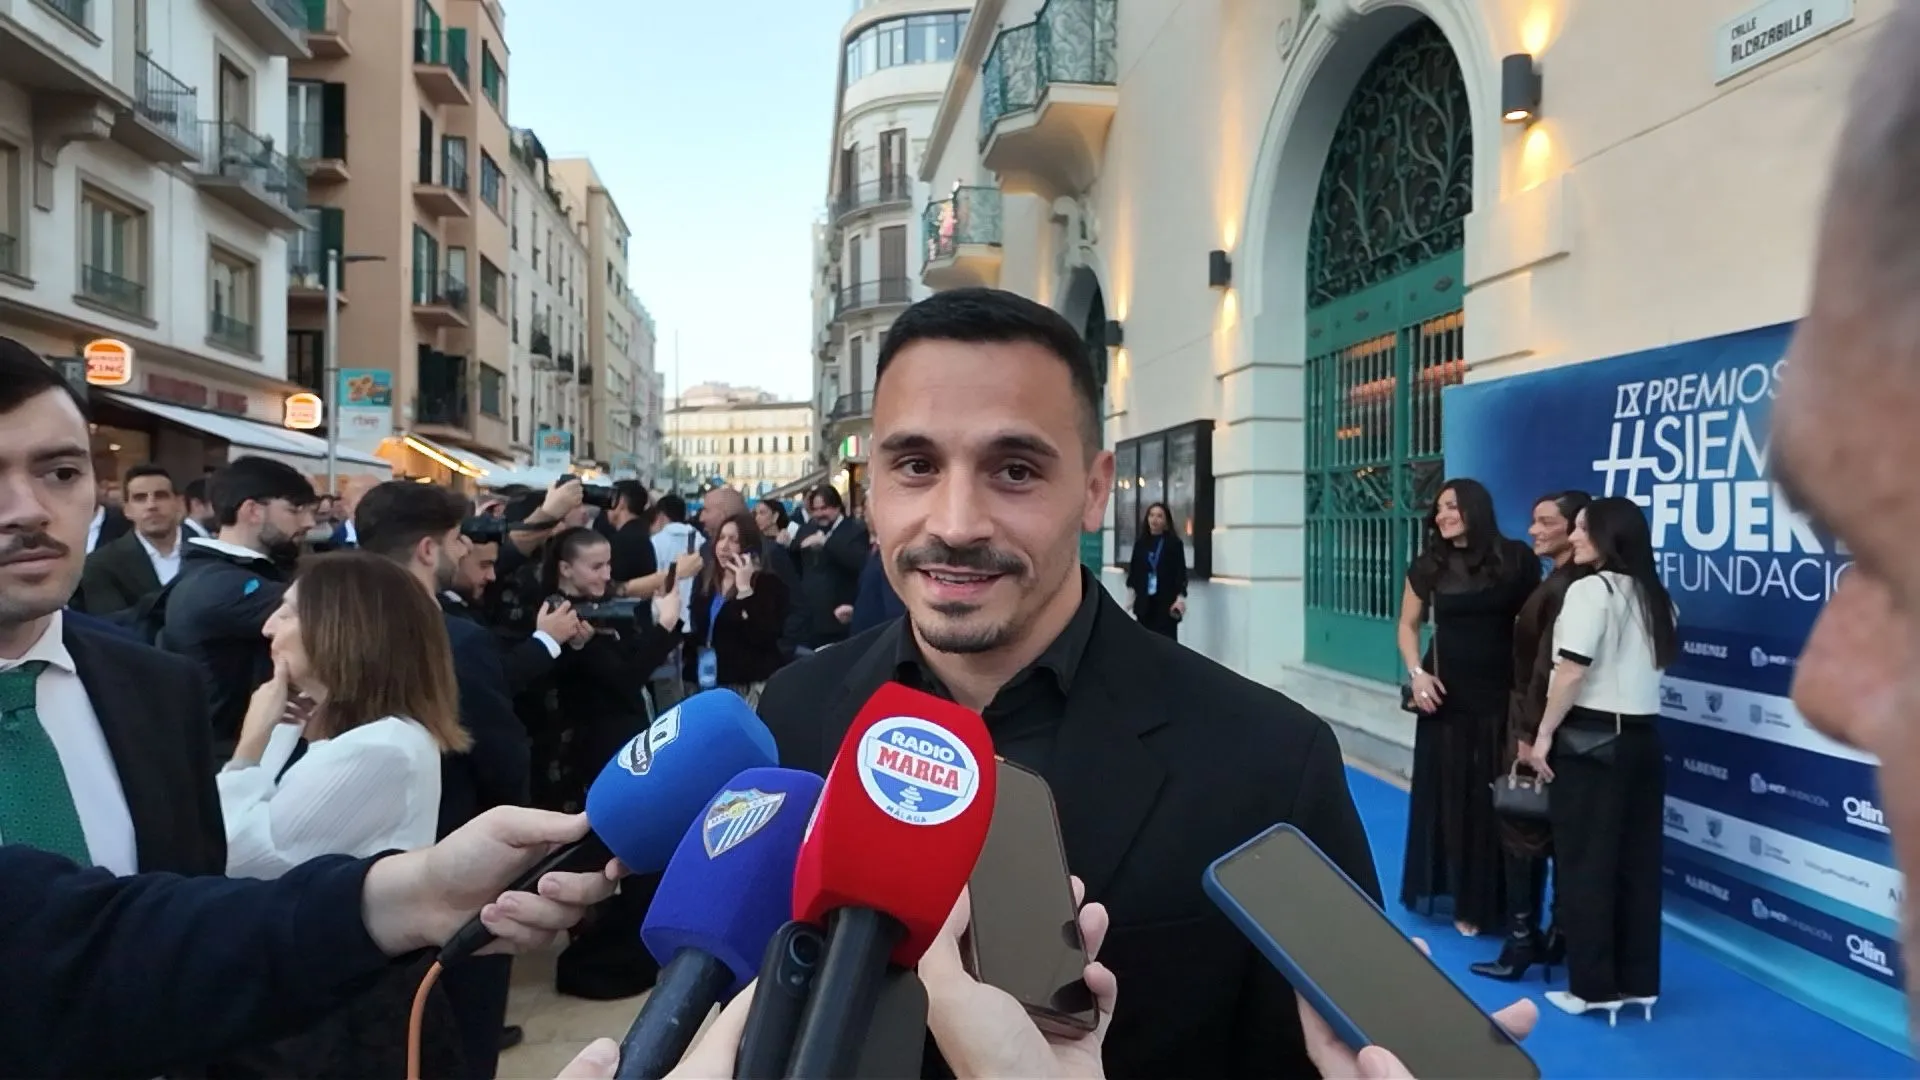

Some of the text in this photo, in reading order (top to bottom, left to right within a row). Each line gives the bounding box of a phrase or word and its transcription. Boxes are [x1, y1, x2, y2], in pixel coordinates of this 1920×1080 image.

[1731, 17, 1757, 40] CALLE
[1731, 9, 1812, 64] ALCAZABILLA
[1614, 360, 1788, 419] IX PREMIOS
[1592, 407, 1771, 507] #SIEM
[891, 731, 955, 762] RADIO
[876, 746, 959, 791] MARCA
[1843, 796, 1884, 825] Olin
[1846, 934, 1887, 966] Olin
